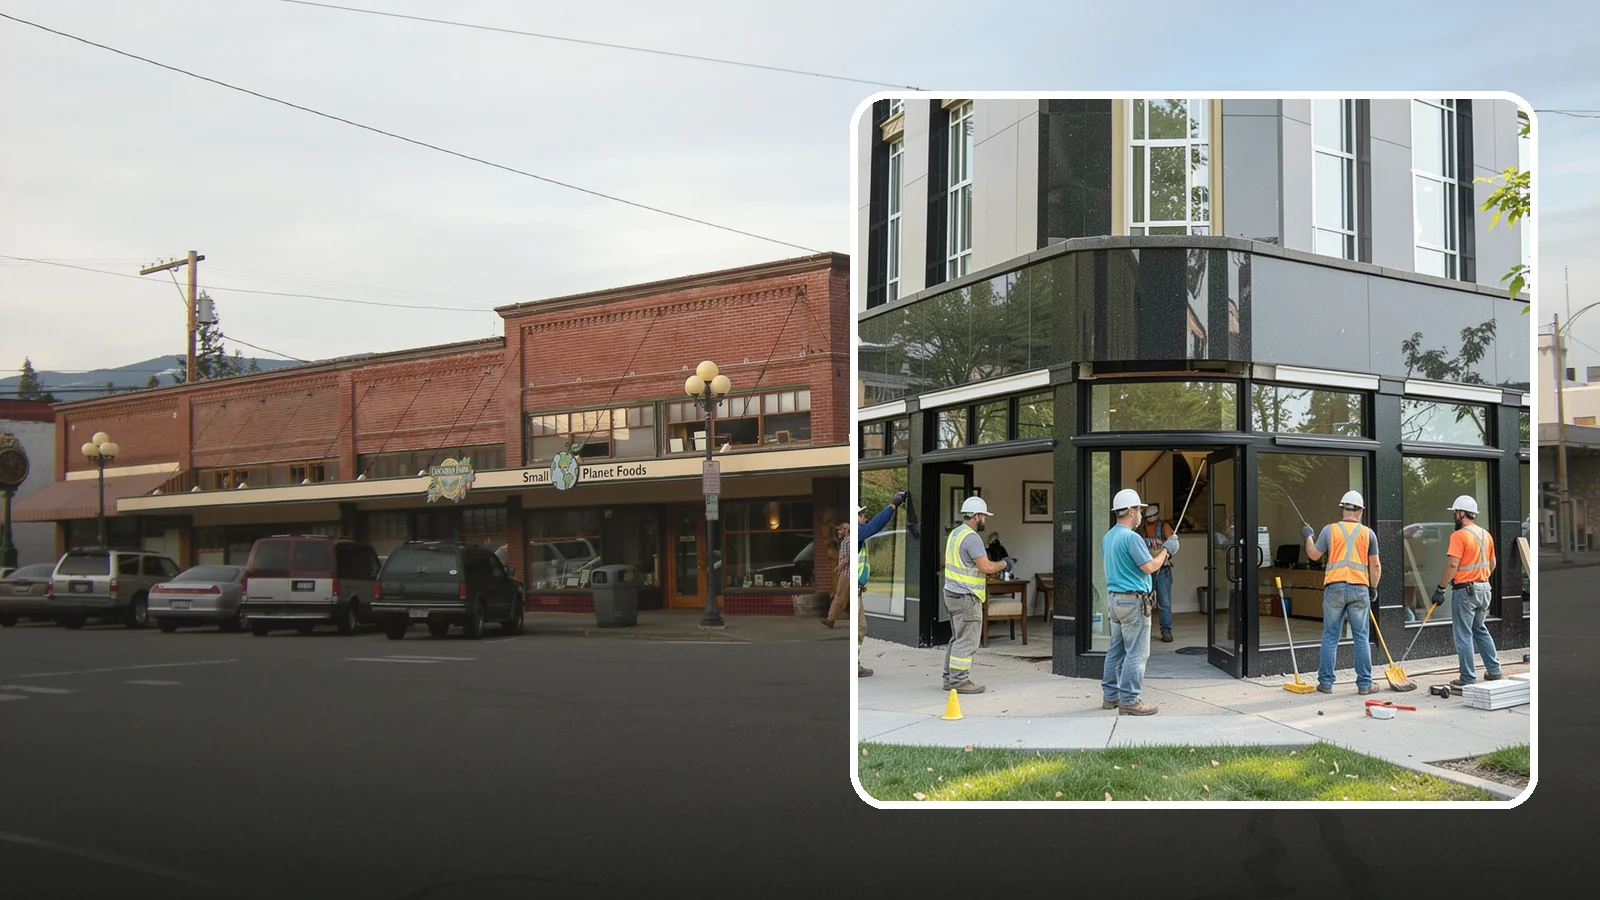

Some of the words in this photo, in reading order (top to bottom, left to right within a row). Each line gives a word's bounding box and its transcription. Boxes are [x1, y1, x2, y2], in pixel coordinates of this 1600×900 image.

[523, 471, 549, 483] Small
[583, 468, 614, 479] Planet
[617, 464, 647, 477] Foods
